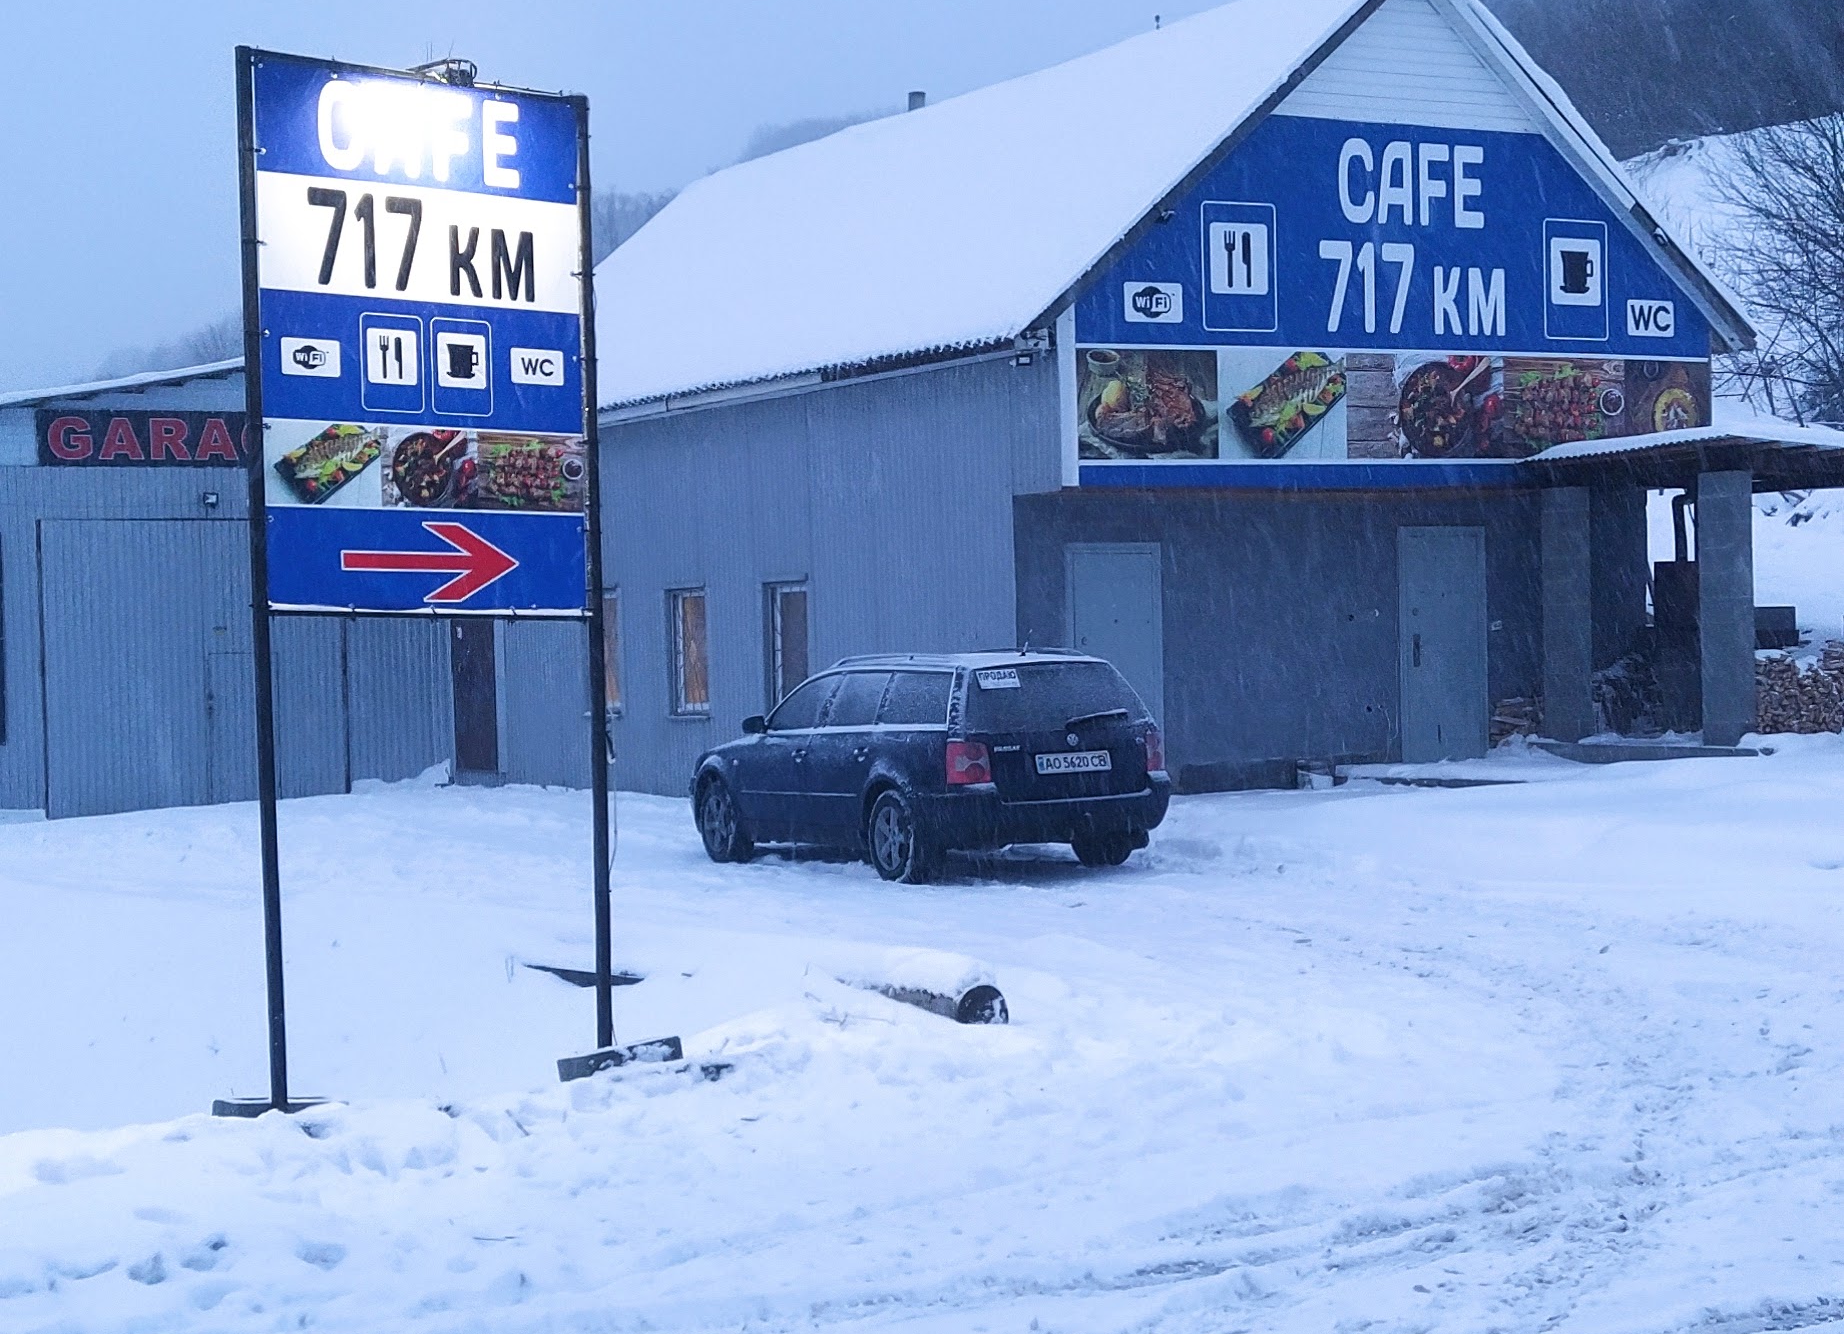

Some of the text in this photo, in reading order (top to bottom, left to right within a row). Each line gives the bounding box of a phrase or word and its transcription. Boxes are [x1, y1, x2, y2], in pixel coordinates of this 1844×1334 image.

[1338, 138, 1485, 229] CAFE
[307, 186, 422, 292] 717
[1319, 239, 1415, 334] 717
[1630, 304, 1671, 332] WC
[520, 357, 554, 377] WC
[47, 416, 248, 461] GARA
[1063, 755, 1089, 769] 5620
